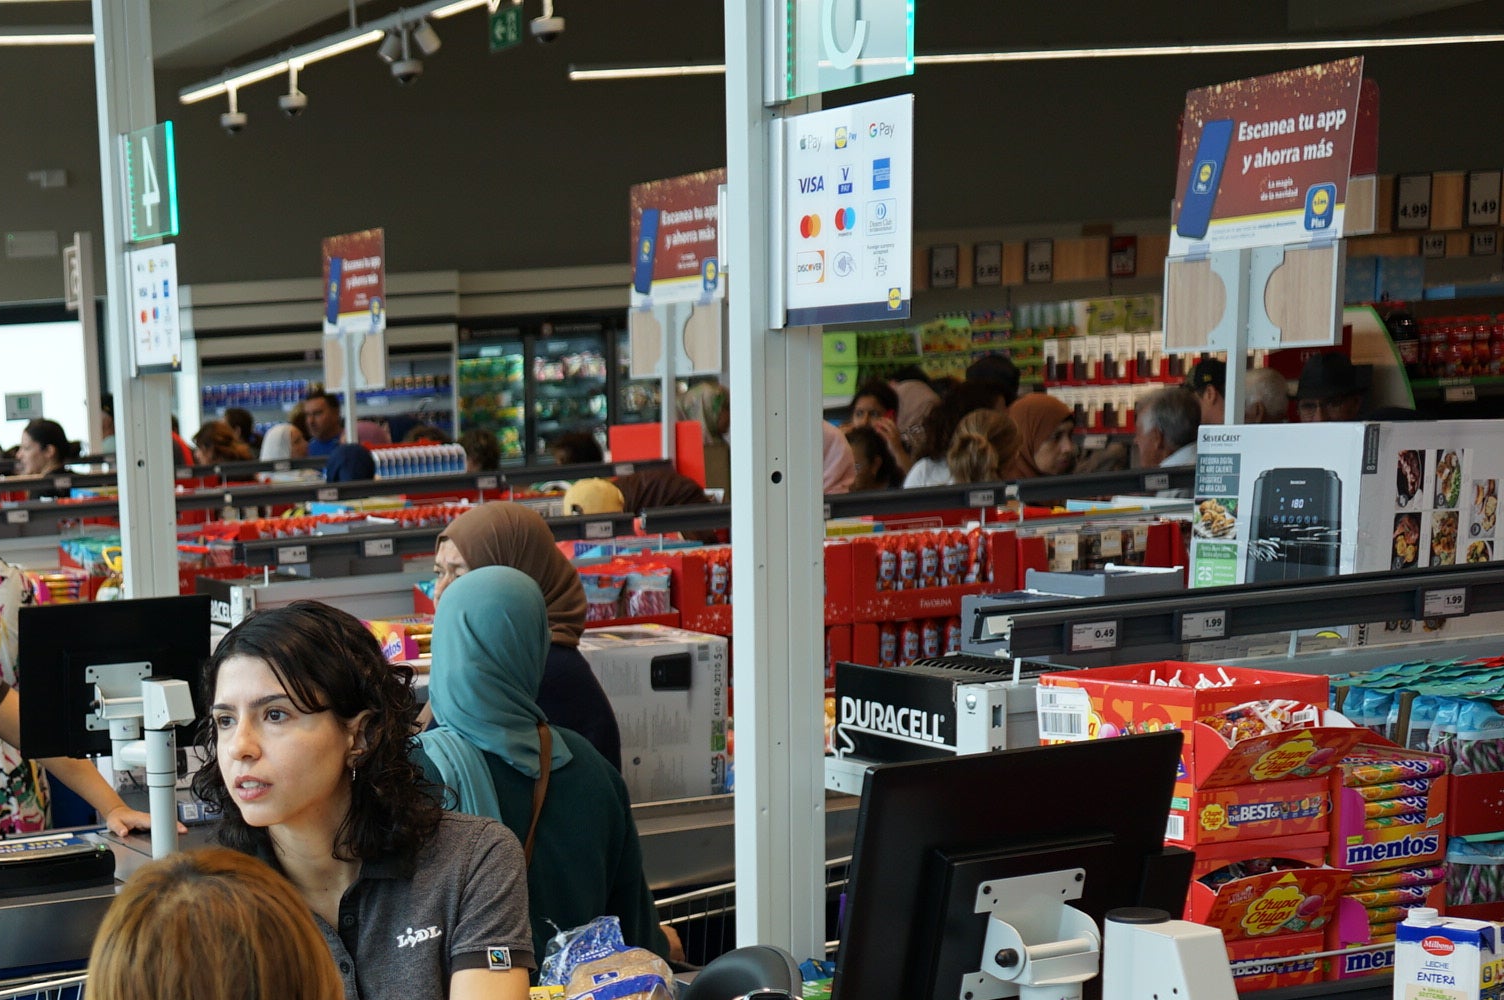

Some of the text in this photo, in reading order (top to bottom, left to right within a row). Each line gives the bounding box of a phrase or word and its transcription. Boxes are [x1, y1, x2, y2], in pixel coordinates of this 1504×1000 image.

[879, 121, 895, 139] Pay
[1238, 108, 1347, 142] Escanea tu app
[807, 134, 824, 152] Pay
[1241, 139, 1334, 175] y ahorra más
[841, 166, 849, 182] V
[798, 175, 825, 194] VISA
[1400, 203, 1427, 218] 4.99
[1472, 201, 1496, 215] 1.49
[1310, 217, 1326, 228] Plus
[797, 263, 822, 273] DISCOVER
[920, 599, 952, 609] FAVORINA
[1446, 595, 1462, 605] 1.99
[1205, 617, 1222, 629] 1.99
[1095, 628, 1115, 639] 0.49
[841, 696, 945, 744] DURACELL
[1268, 745, 1310, 766] Chupa
[1256, 758, 1297, 776] Chups
[1240, 803, 1272, 820] BEST
[1347, 835, 1439, 864] mentos
[1255, 897, 1297, 913] Chupa
[1245, 909, 1294, 929] Chups
[1421, 939, 1454, 952] Milbona
[1347, 949, 1395, 972] men
[1425, 959, 1449, 969] LECHE
[1417, 972, 1456, 985] ENTERA
